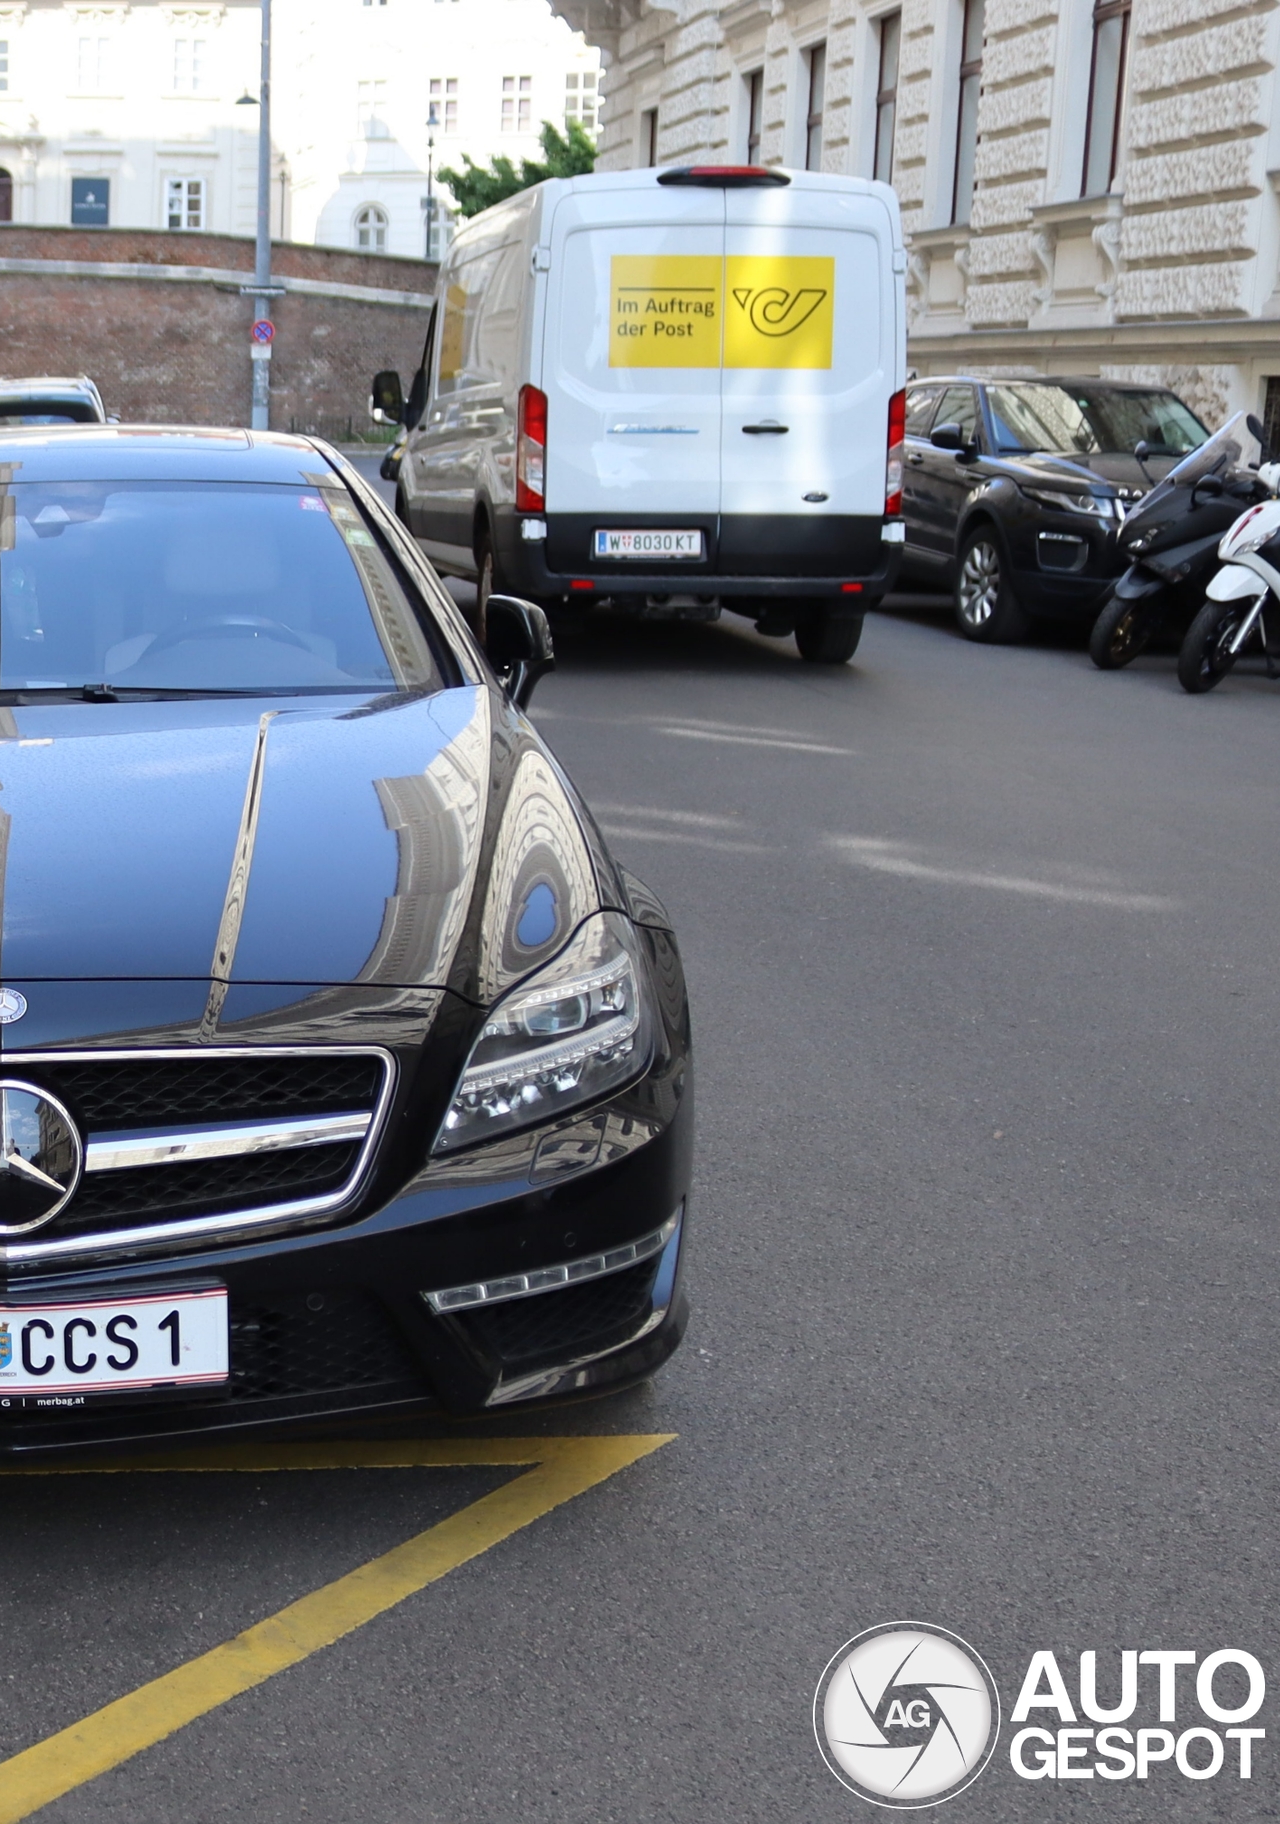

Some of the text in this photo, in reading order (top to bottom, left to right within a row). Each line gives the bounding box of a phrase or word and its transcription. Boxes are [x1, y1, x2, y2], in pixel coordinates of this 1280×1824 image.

[617, 297, 715, 318] Im Auftrag
[617, 320, 693, 337] der Post
[609, 535, 621, 551] W
[21, 1314, 139, 1376] CCS
[158, 1309, 180, 1367] 1
[37, 1396, 85, 1407] merbag.at
